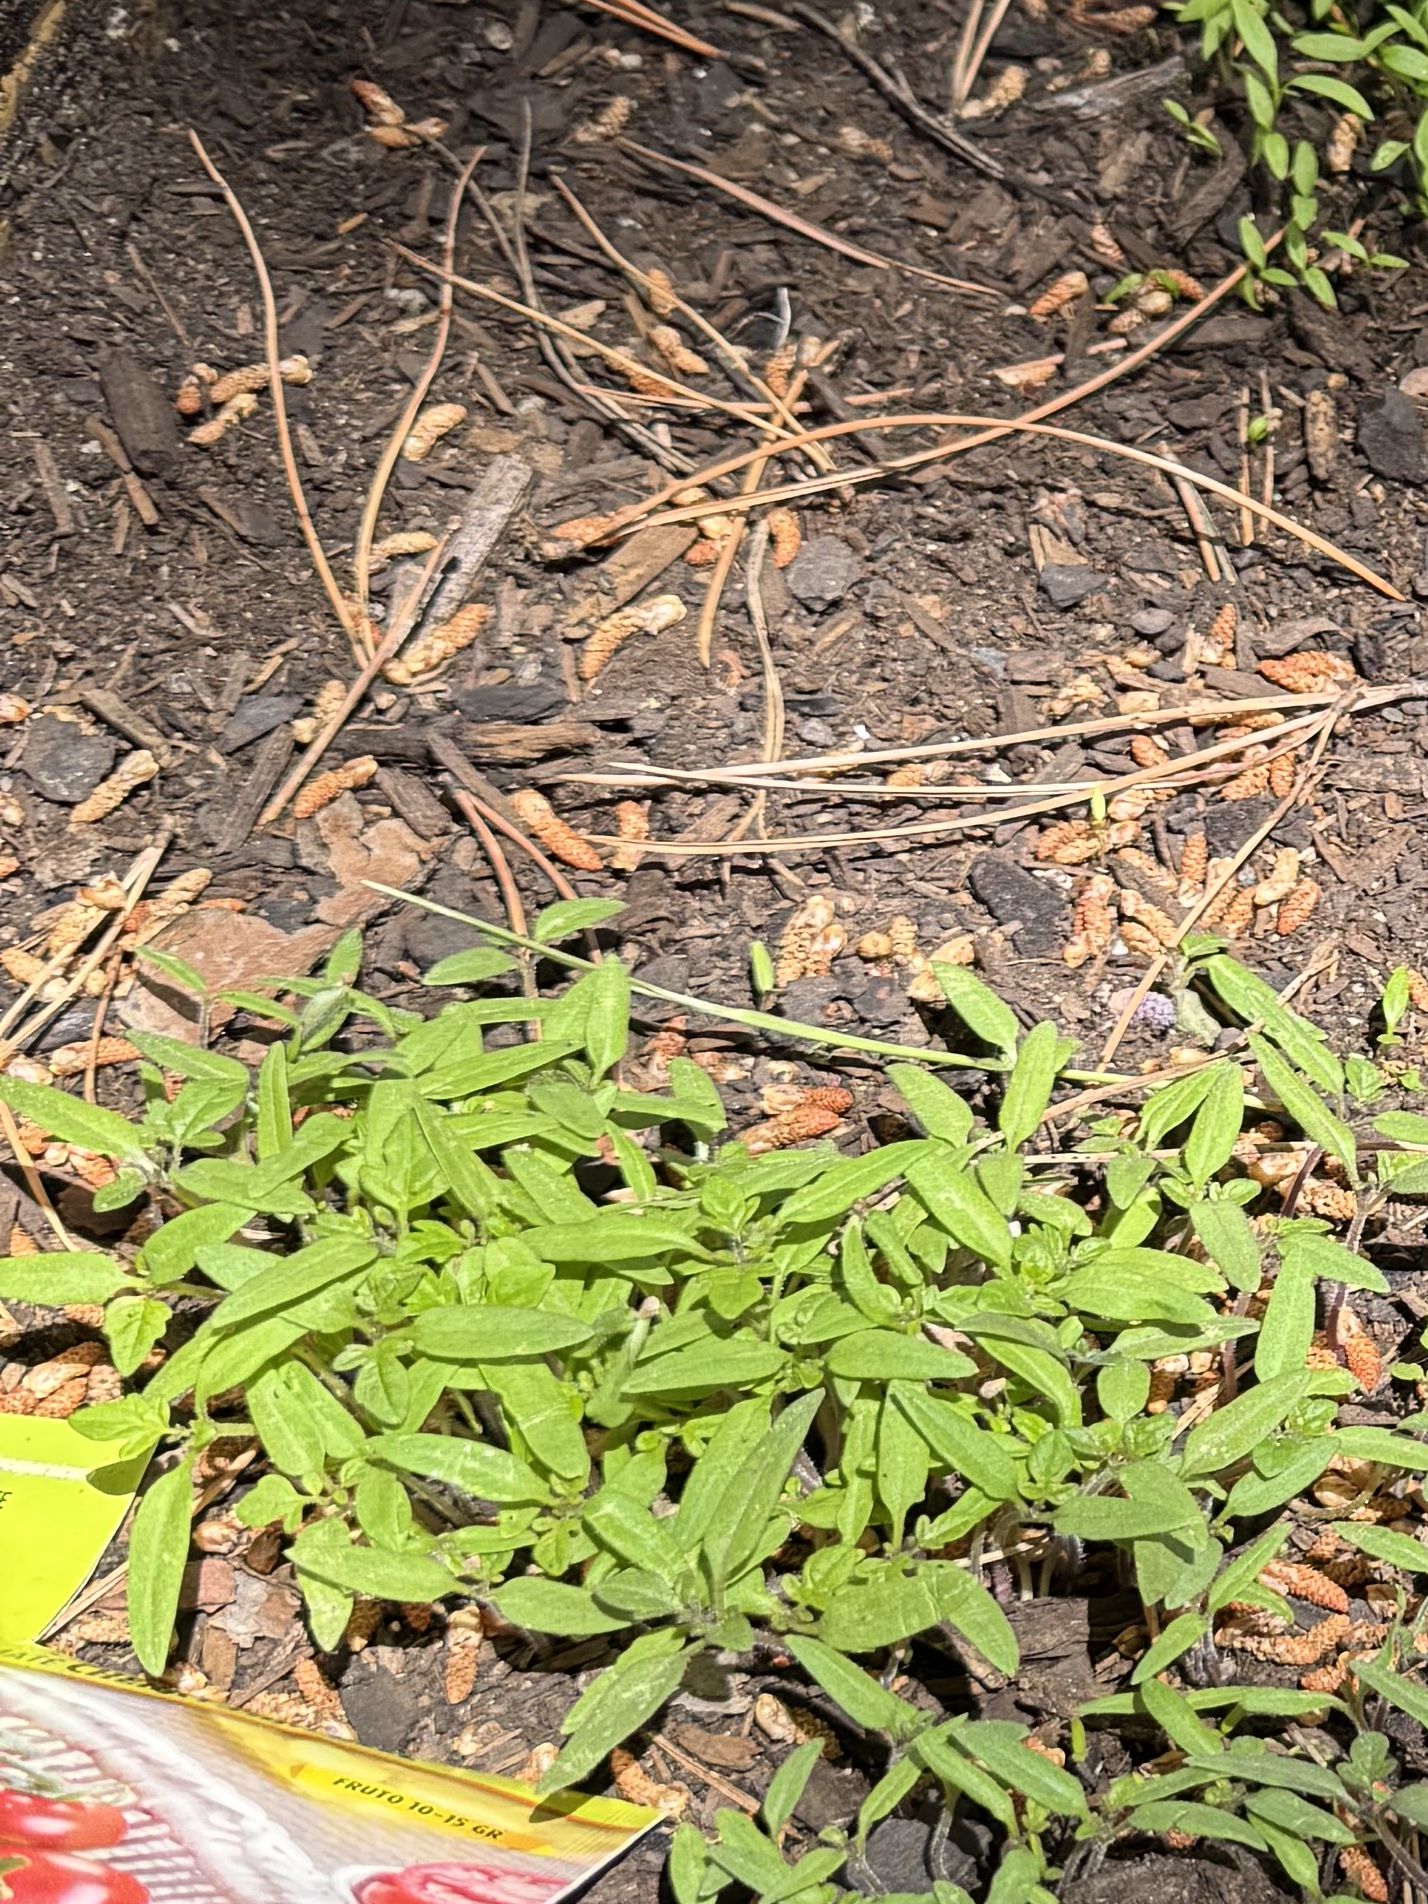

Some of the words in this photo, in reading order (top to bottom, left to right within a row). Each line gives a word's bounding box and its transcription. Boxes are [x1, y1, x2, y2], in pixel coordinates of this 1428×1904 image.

[332, 1777, 404, 1805] FRUTO
[408, 1801, 468, 1827] 10-15
[472, 1824, 504, 1841] GR
